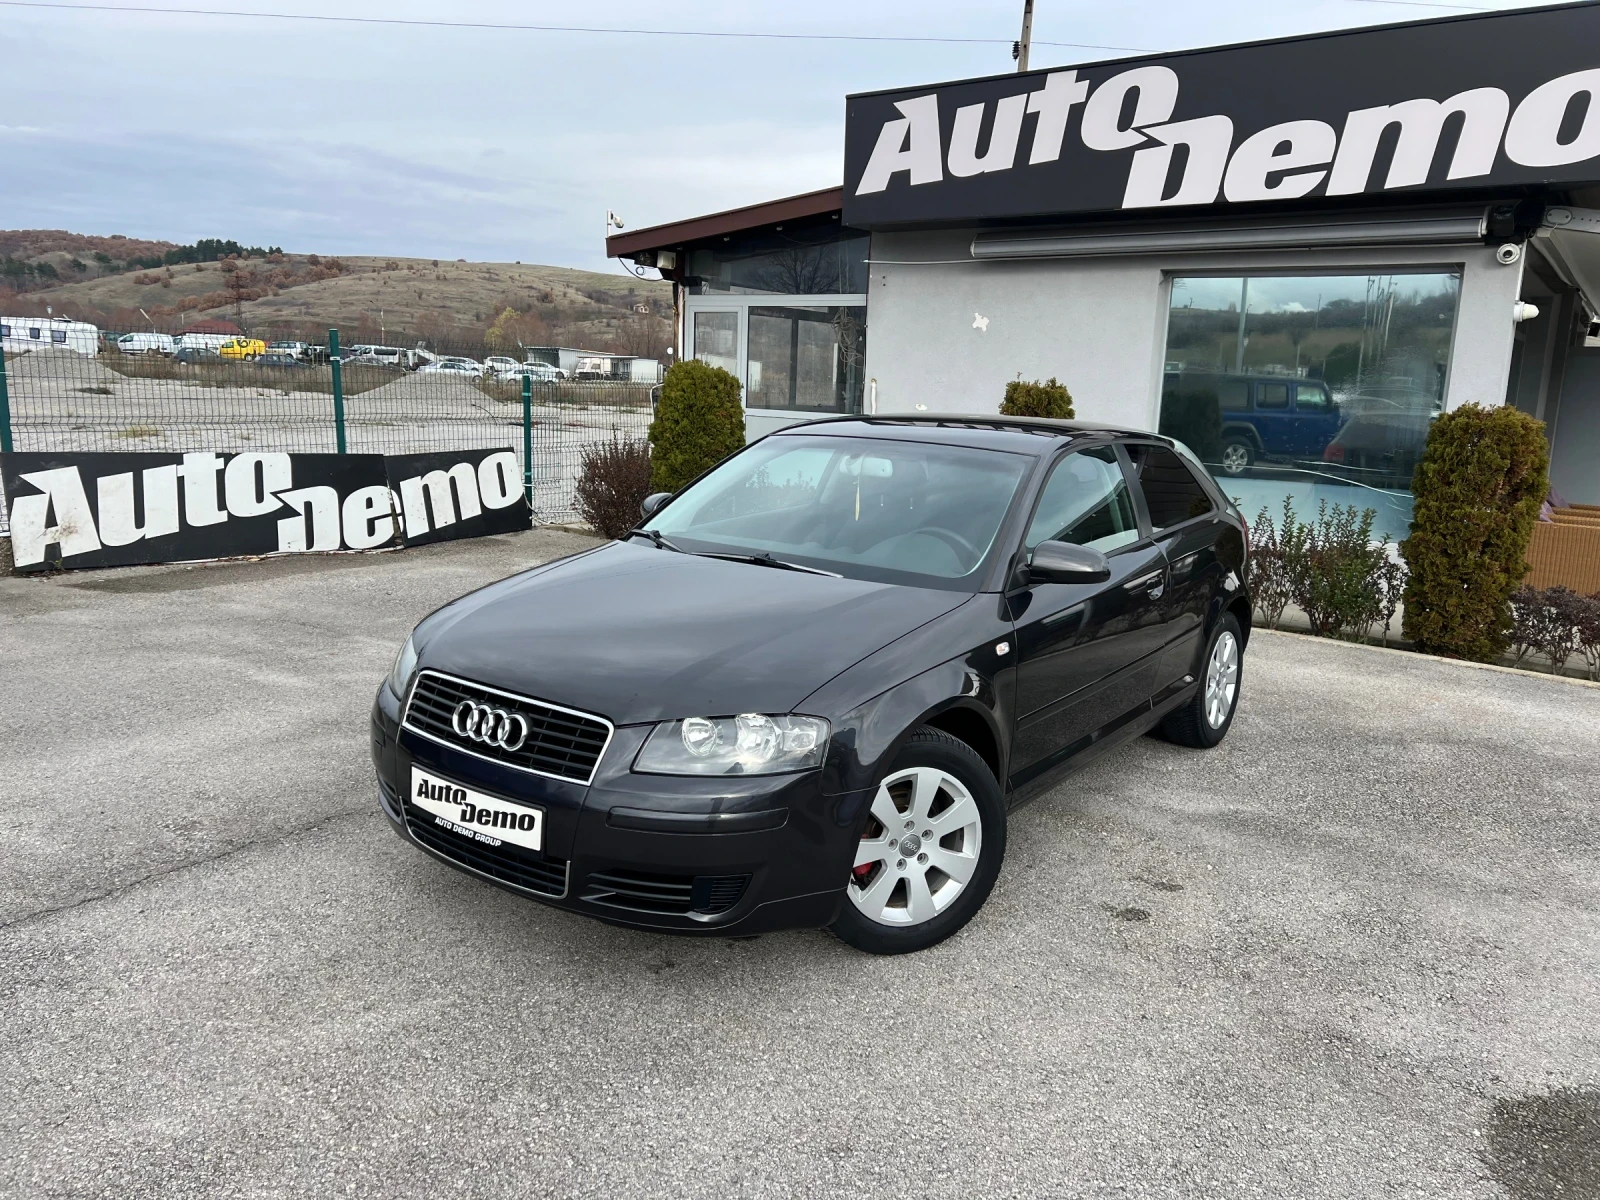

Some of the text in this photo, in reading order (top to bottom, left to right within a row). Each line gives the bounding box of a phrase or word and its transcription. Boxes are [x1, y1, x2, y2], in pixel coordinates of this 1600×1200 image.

[855, 65, 1600, 209] Auto Demo
[10, 451, 524, 567] Auto Demo
[416, 778, 536, 832] Auto Demo
[434, 816, 502, 847] AUTO DEMO GROUP
